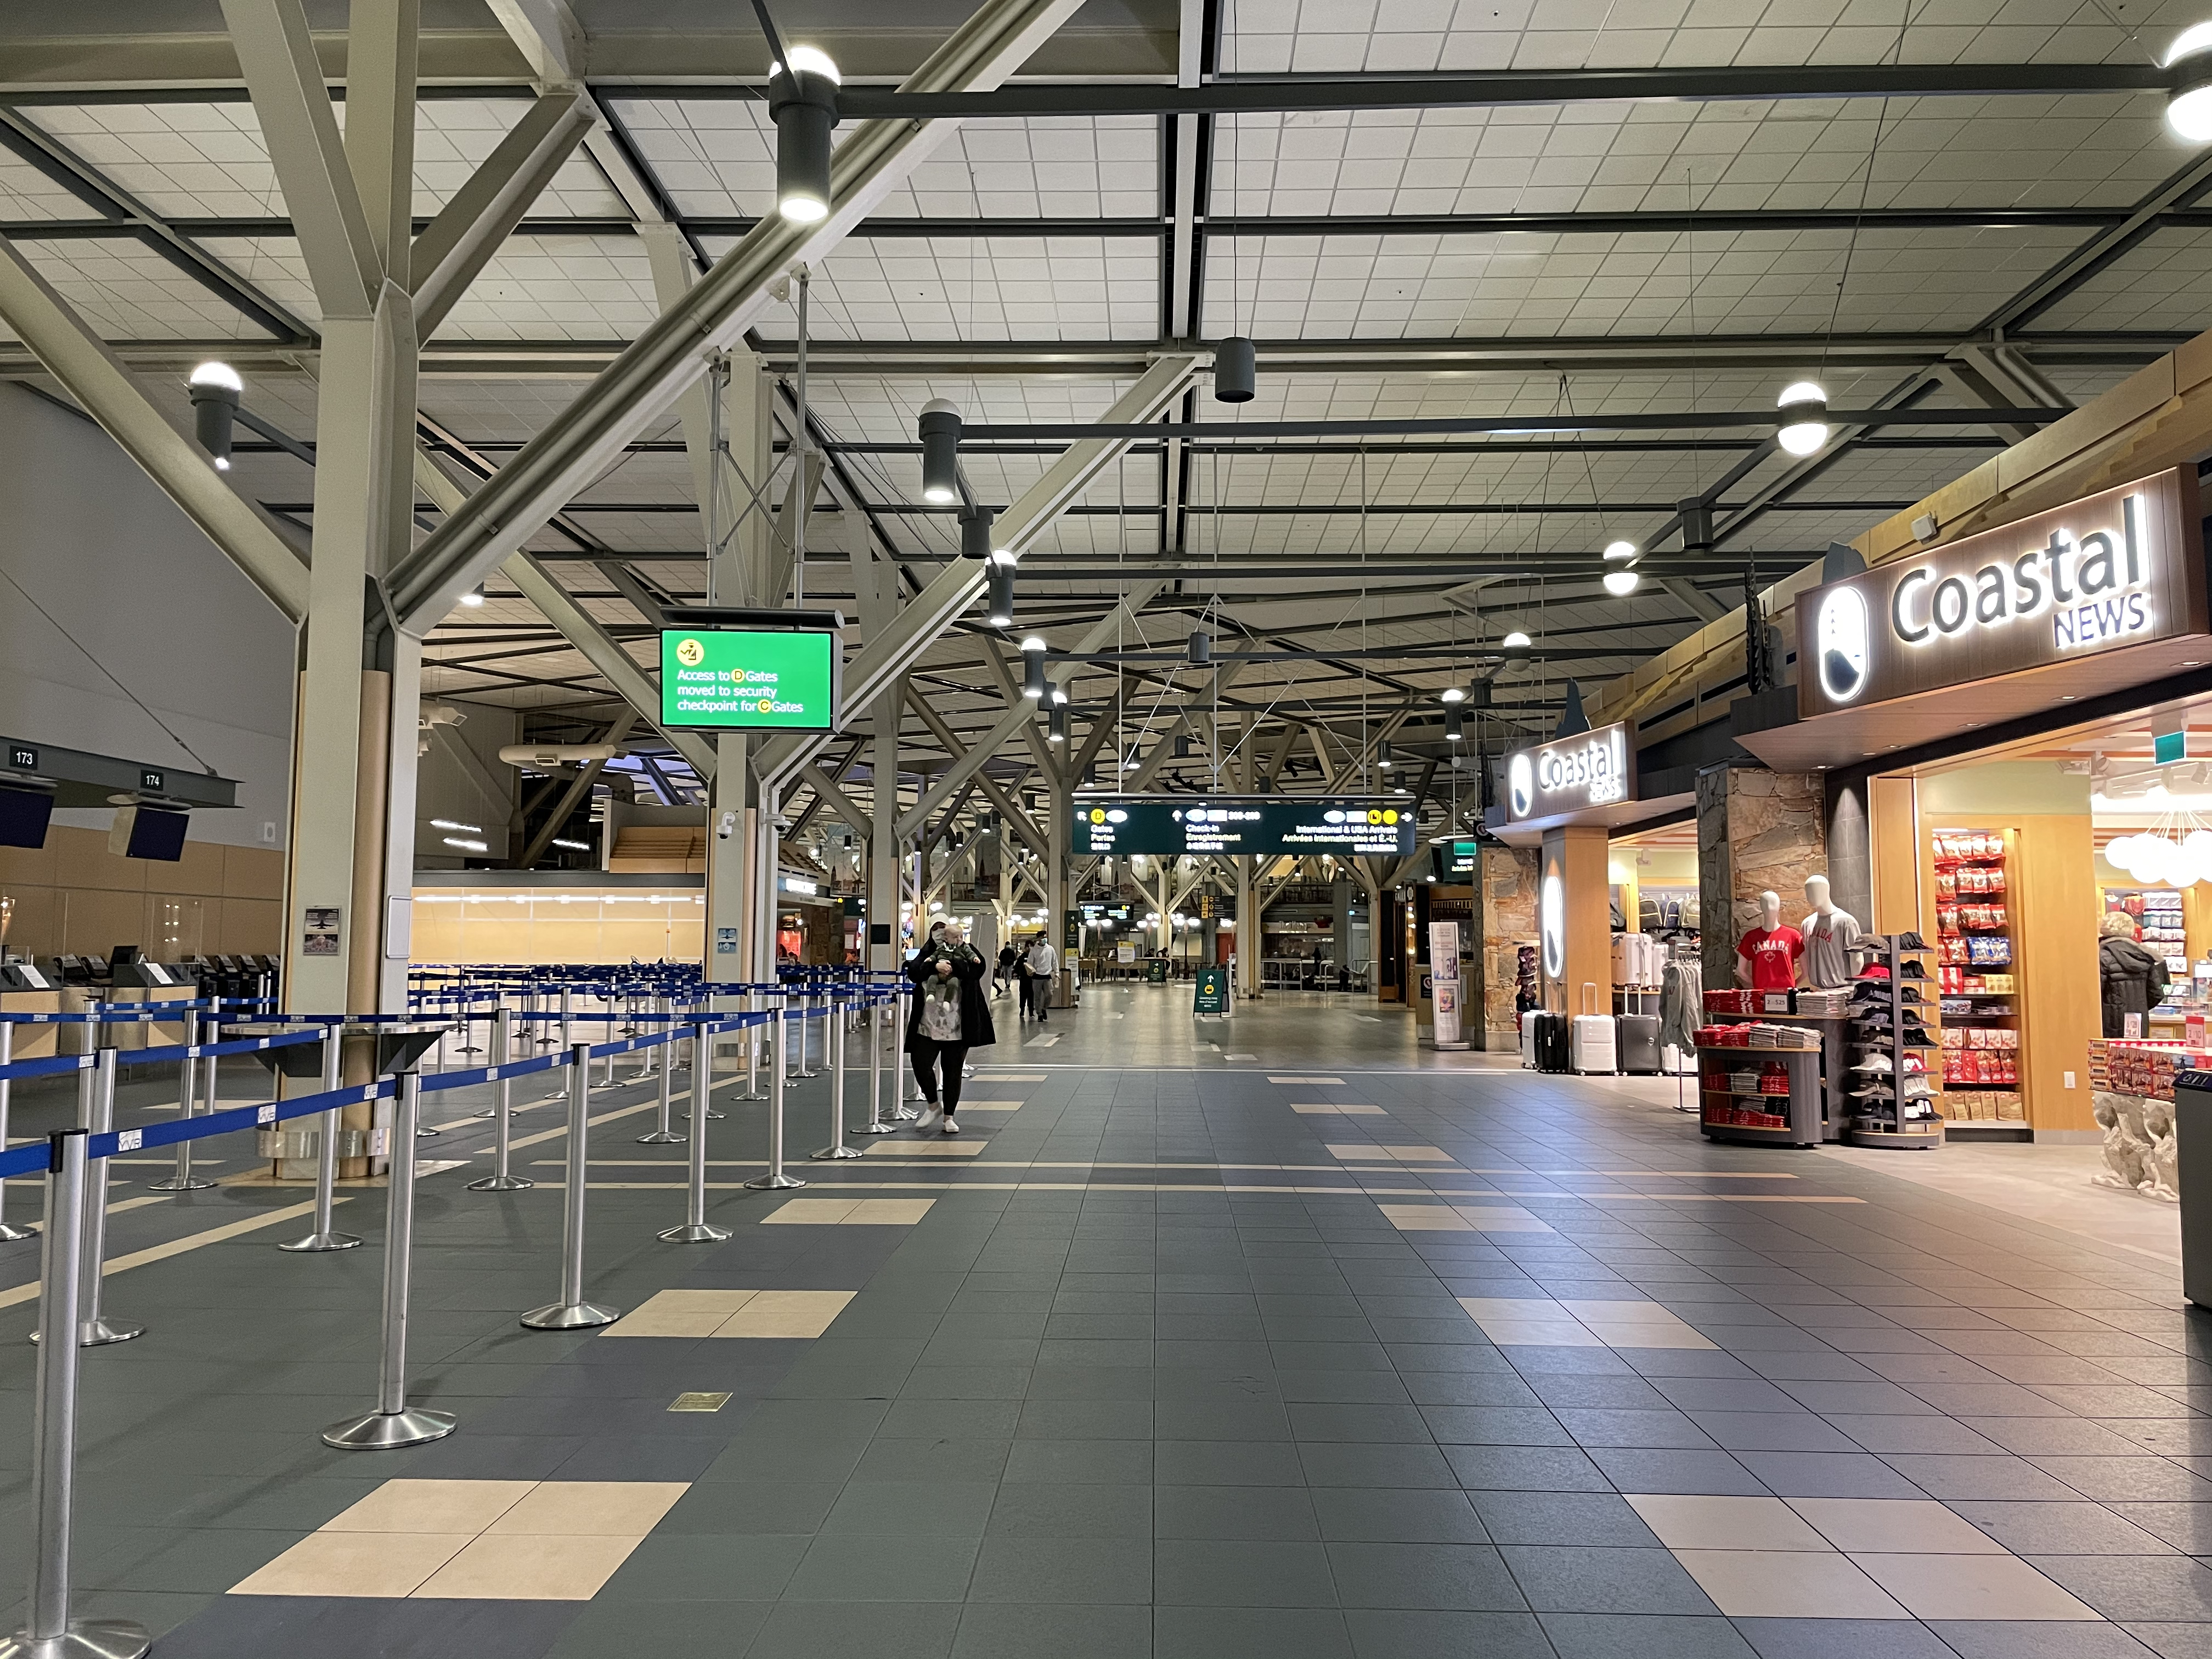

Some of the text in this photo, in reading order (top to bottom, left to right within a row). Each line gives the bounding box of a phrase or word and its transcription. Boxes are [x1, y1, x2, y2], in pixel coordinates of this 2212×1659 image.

[1893, 495, 2143, 643] Coastal
[2053, 594, 2146, 648] NEWS
[678, 669, 778, 682] Access to D Gates
[678, 685, 777, 699] moved to security
[678, 699, 803, 713] checkpoint for C Gates
[16, 752, 32, 765] 173
[1538, 731, 1620, 790] Coastal
[146, 775, 160, 786] 174
[1186, 824, 1219, 833] Check-in
[1296, 825, 1342, 833] International
[1351, 825, 1368, 833] USA
[1369, 825, 1398, 833] Arrivals
[1091, 833, 1115, 842] Portes
[1186, 833, 1241, 843] Enregistrement
[1282, 833, 1313, 842] Arrivées
[1314, 834, 1368, 842] internationales
[1752, 940, 1790, 955] CANADA
[119, 1138, 142, 1152] YVR
